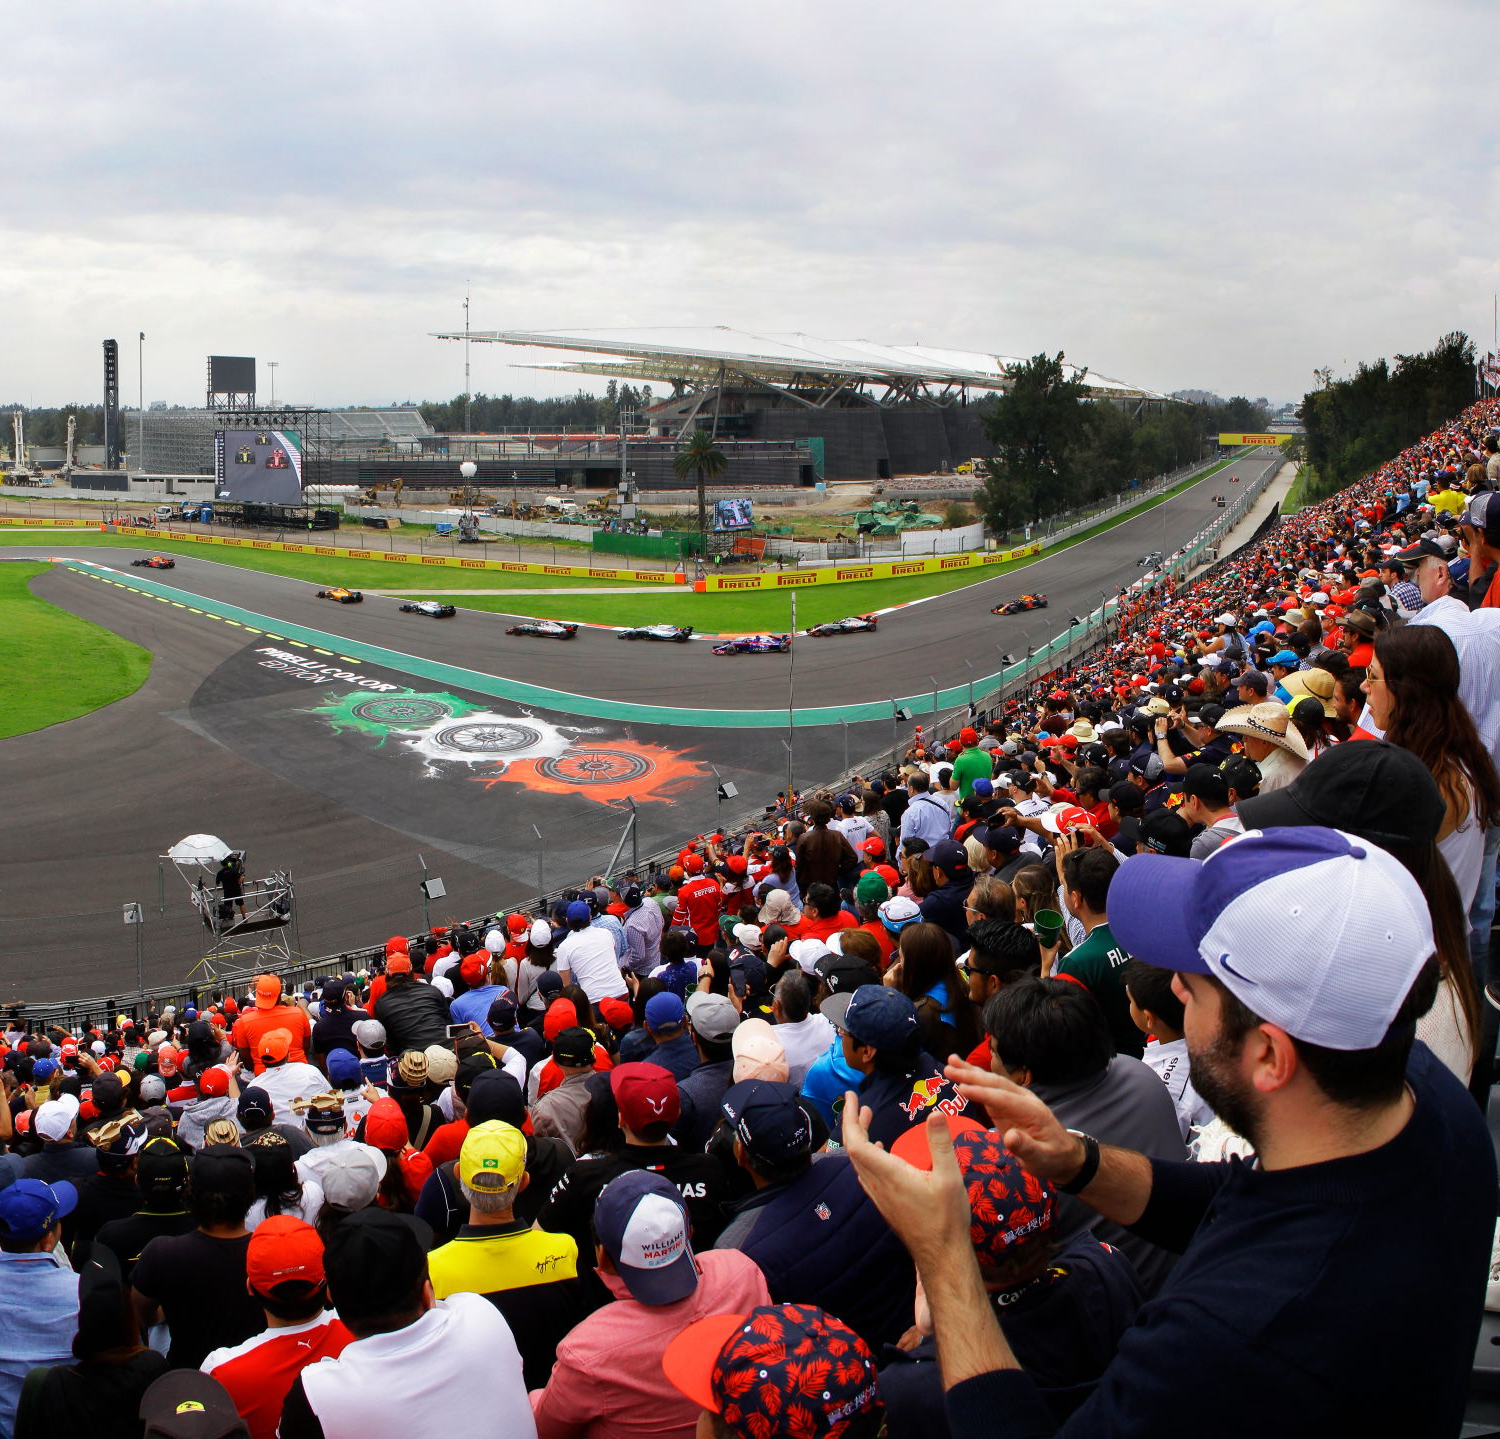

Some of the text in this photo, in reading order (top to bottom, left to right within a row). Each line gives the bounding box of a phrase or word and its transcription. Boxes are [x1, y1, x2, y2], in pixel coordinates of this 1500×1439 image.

[1242, 435, 1276, 445] PIRELLI
[421, 556, 446, 565] PIRELLI
[460, 560, 485, 568] PIRELLI
[940, 556, 970, 569] PIRELLI
[983, 554, 1003, 564] PIRELLI
[501, 562, 528, 572] PIRELLI
[544, 565, 572, 575] PIRELLI
[892, 562, 925, 575] PIRELLI
[588, 569, 618, 578] PIRELLI
[635, 572, 665, 581] PIRELLI
[777, 573, 818, 586] PIRELLI
[837, 568, 874, 581] PIRELLI
[717, 577, 761, 589] PIRELLI
[255, 647, 398, 692] PIRELLI COLOR
[258, 660, 334, 684] EDITION
[937, 1083, 969, 1117] Bul
[641, 1230, 684, 1251] WILLIAMS
[643, 1240, 683, 1260] MARTINI
